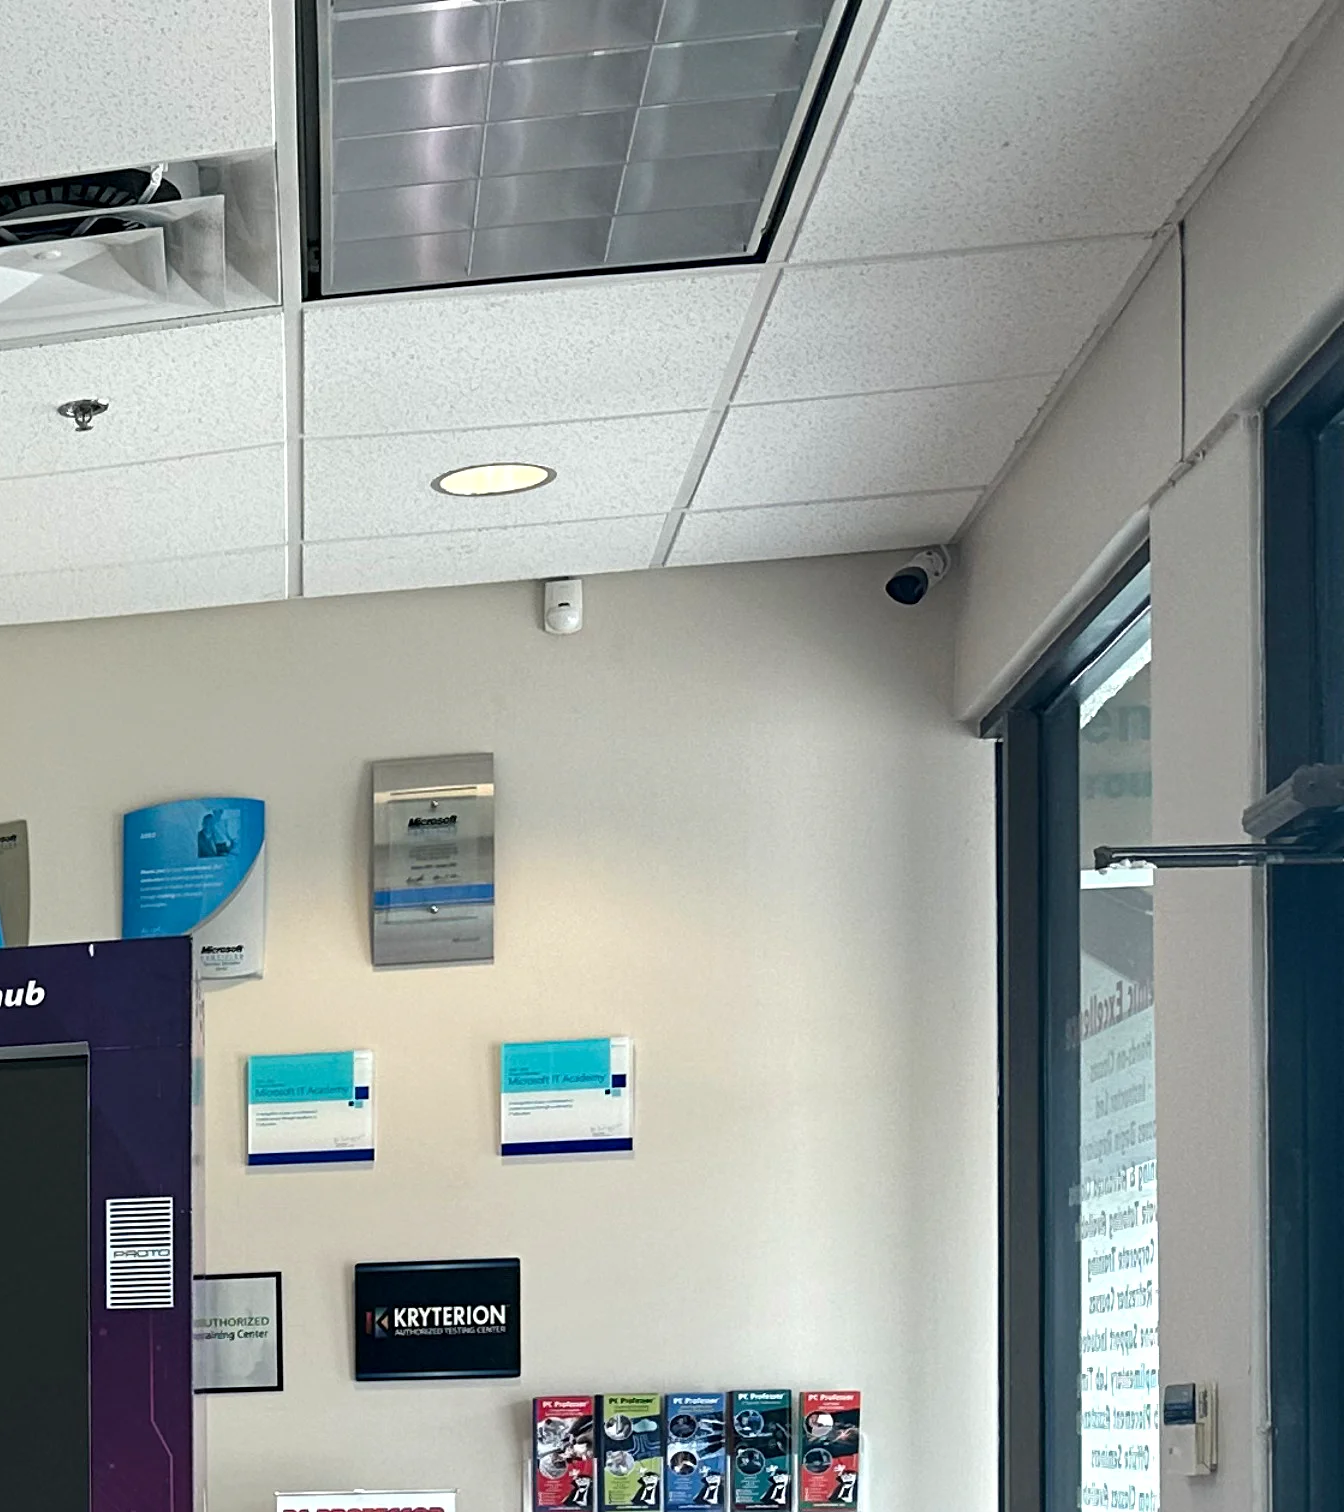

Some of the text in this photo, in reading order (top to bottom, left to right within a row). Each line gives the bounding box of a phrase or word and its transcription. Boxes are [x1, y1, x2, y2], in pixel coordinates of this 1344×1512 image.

[407, 815, 458, 828] Microsoft
[201, 945, 245, 954] Microsoft
[113, 1249, 171, 1259] PROTO
[197, 1316, 270, 1328] UTHORIZED
[393, 1304, 507, 1329] KRYTERION
[394, 1325, 507, 1337] AUTHORIZED TESTING CENTER
